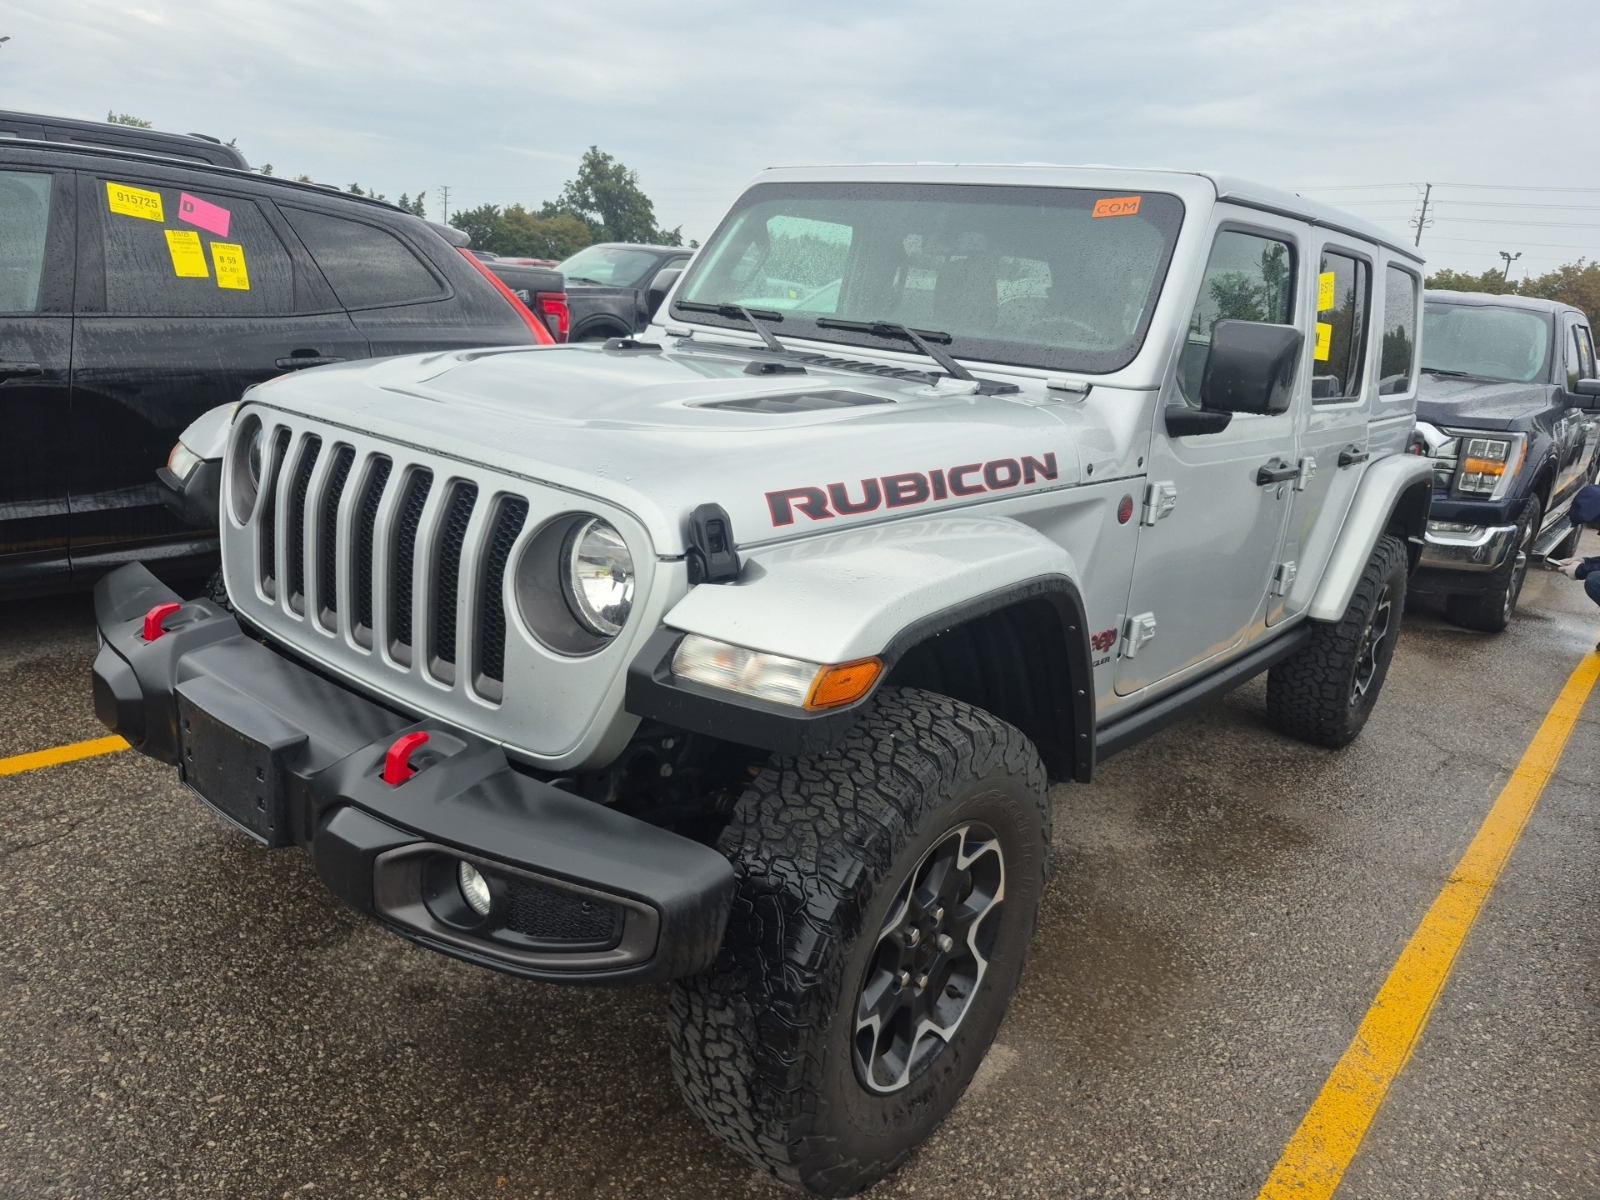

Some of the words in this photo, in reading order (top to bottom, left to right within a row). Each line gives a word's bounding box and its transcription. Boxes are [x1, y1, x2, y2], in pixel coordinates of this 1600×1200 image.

[117, 192, 158, 209] 915725
[183, 200, 195, 213] D
[1097, 202, 1137, 214] COM
[764, 452, 1059, 528] RUBICON
